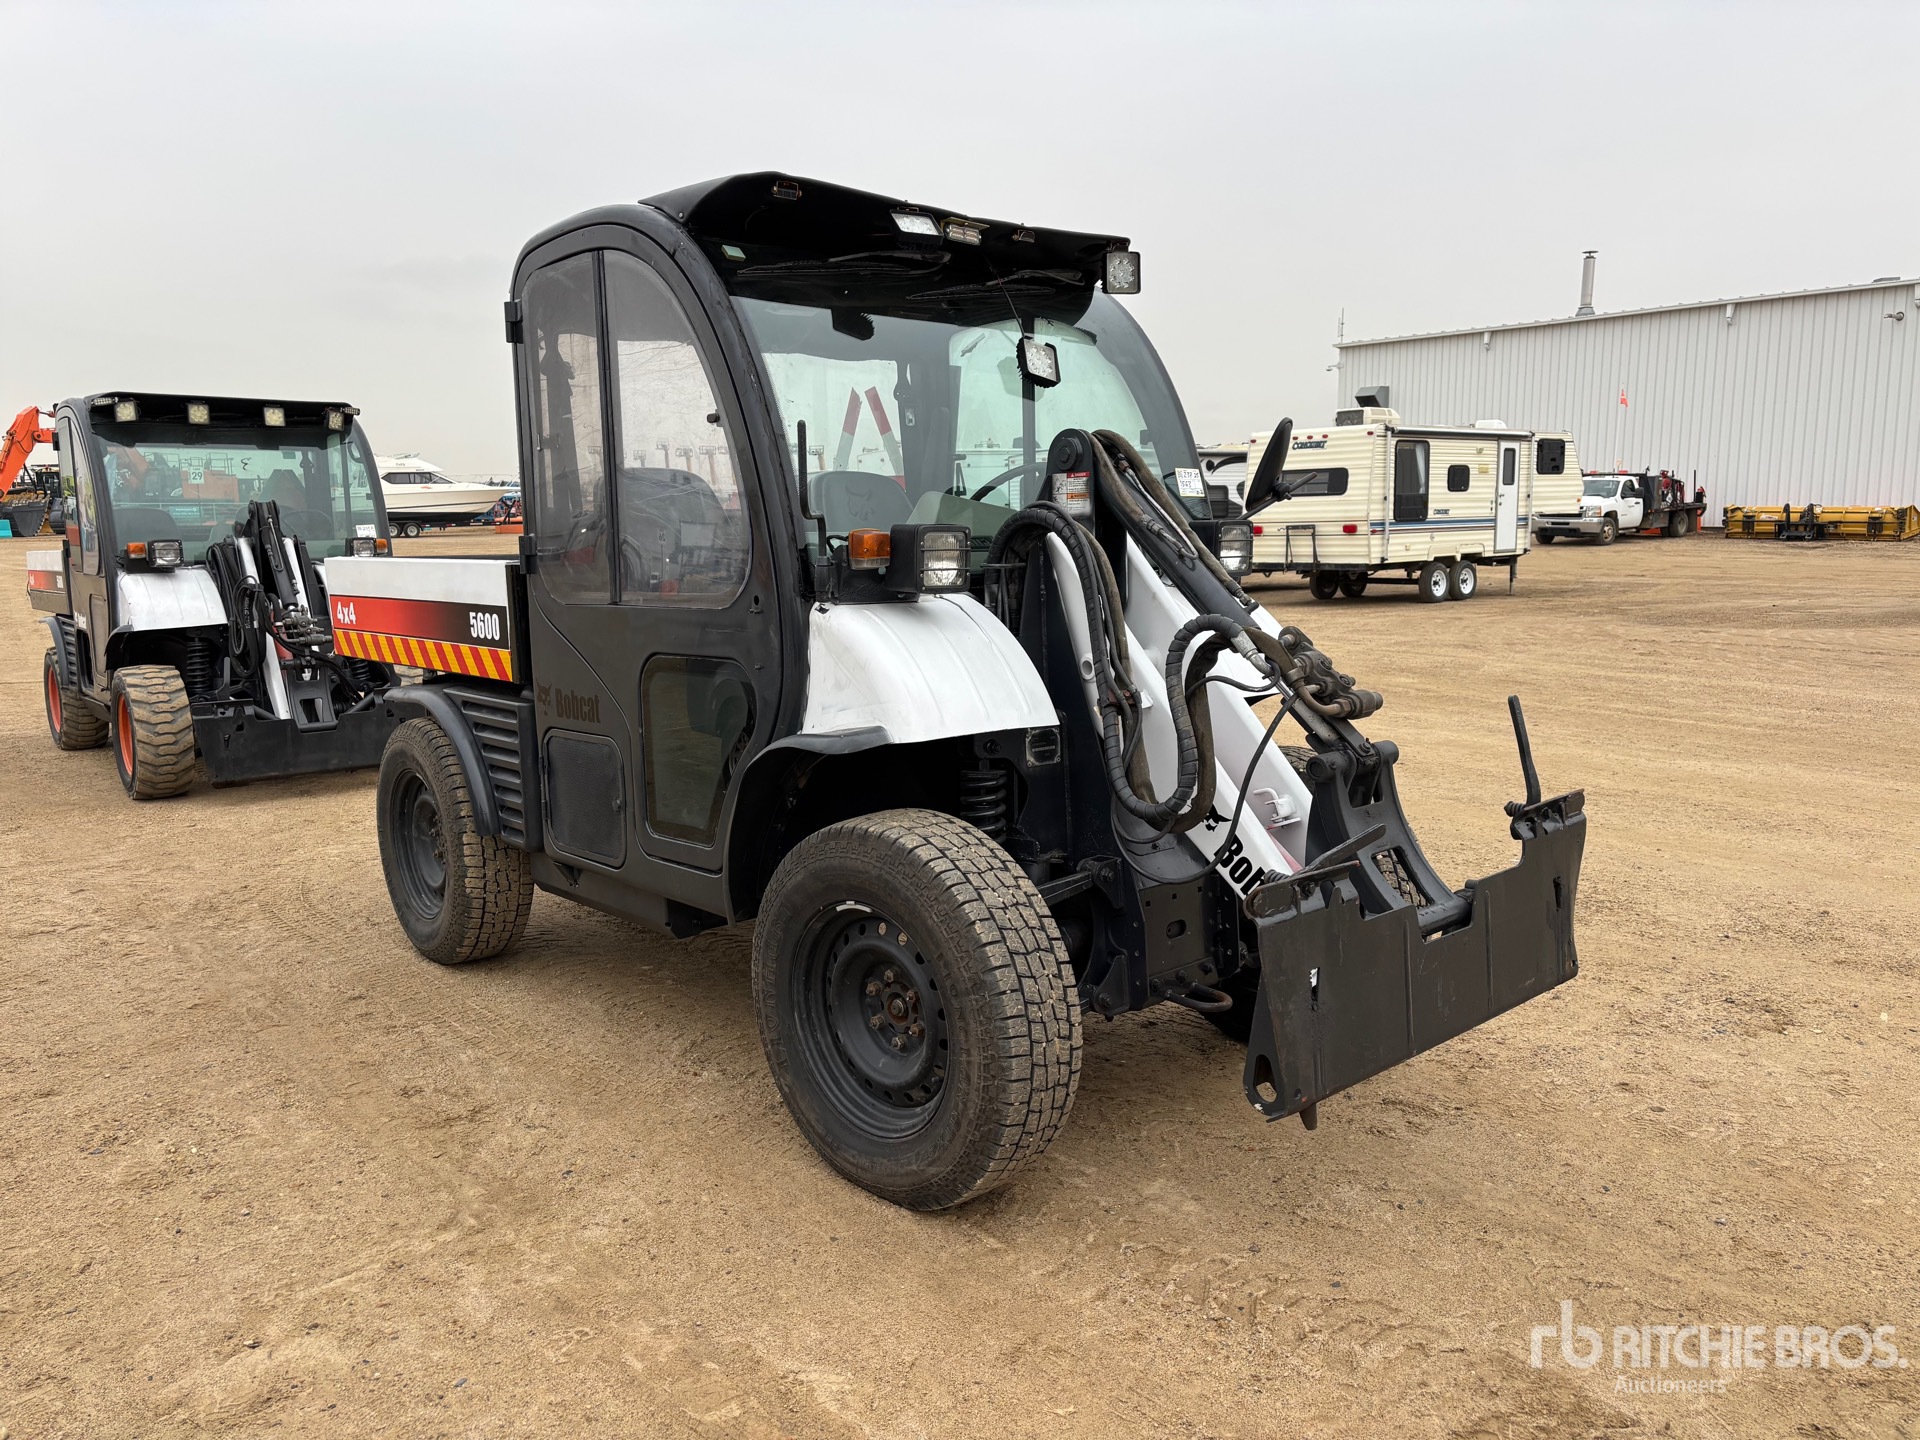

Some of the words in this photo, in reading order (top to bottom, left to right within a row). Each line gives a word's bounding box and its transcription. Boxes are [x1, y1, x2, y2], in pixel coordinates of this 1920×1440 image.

[192, 471, 203, 480] 29
[336, 601, 357, 625] 4x4
[469, 611, 500, 641] 5600
[554, 687, 601, 723] Bobcat
